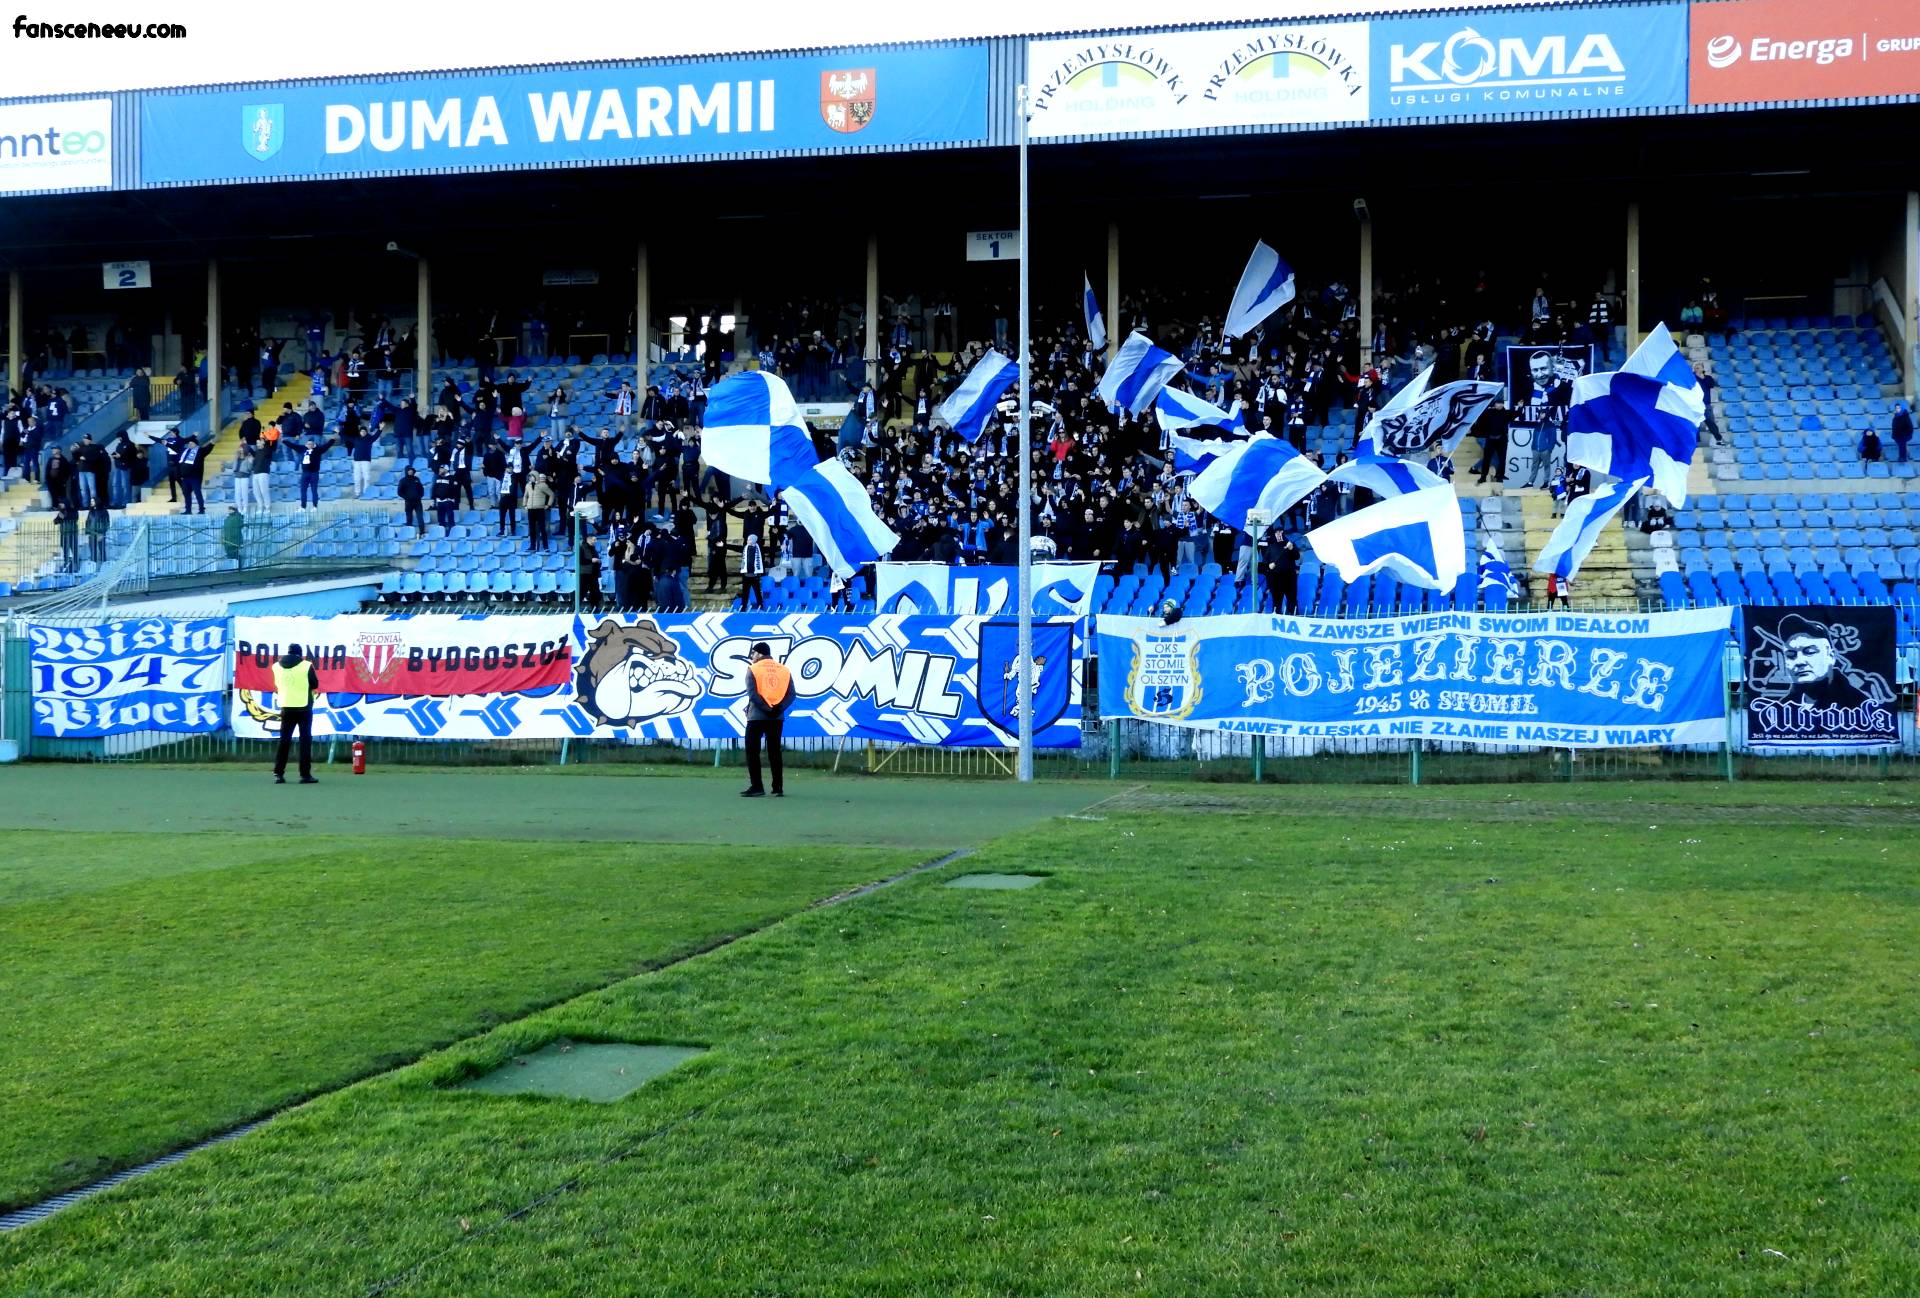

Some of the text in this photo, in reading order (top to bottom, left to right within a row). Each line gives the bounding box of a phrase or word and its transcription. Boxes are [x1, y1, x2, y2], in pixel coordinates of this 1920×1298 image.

[1390, 26, 1626, 85] KOMA
[1750, 38, 1853, 65] Energa
[1035, 42, 1188, 111] PRZEMYSŁÓWKA
[1203, 33, 1362, 102] PRZEMYSŁÓWKA
[1390, 85, 1625, 106] USŁUGI KOMUNALNE
[325, 79, 776, 154] DUMA WARMII
[989, 240, 1000, 258] 1
[118, 269, 137, 287] 2
[359, 633, 400, 644] POLONIA
[1271, 614, 1650, 639] NA ZAWSZE WIERNI SWOIM IDEAŁOM
[407, 633, 569, 673] BYDGOSZCZ
[1154, 643, 1178, 654] OKS
[32, 654, 223, 698] 1947
[1144, 659, 1185, 669] STOMIL
[1234, 634, 1675, 713] POJEZIERZE
[1140, 675, 1189, 685] OLSZTYN
[1353, 691, 1402, 715] 1945
[1437, 690, 1540, 715] STOMIL
[1218, 719, 1293, 735] NAWET
[1389, 720, 1423, 735] NIE
[1430, 721, 1509, 739] ZŁAMIE
[1516, 725, 1599, 743] NASZEJ
[1604, 728, 1676, 744] WIARY
